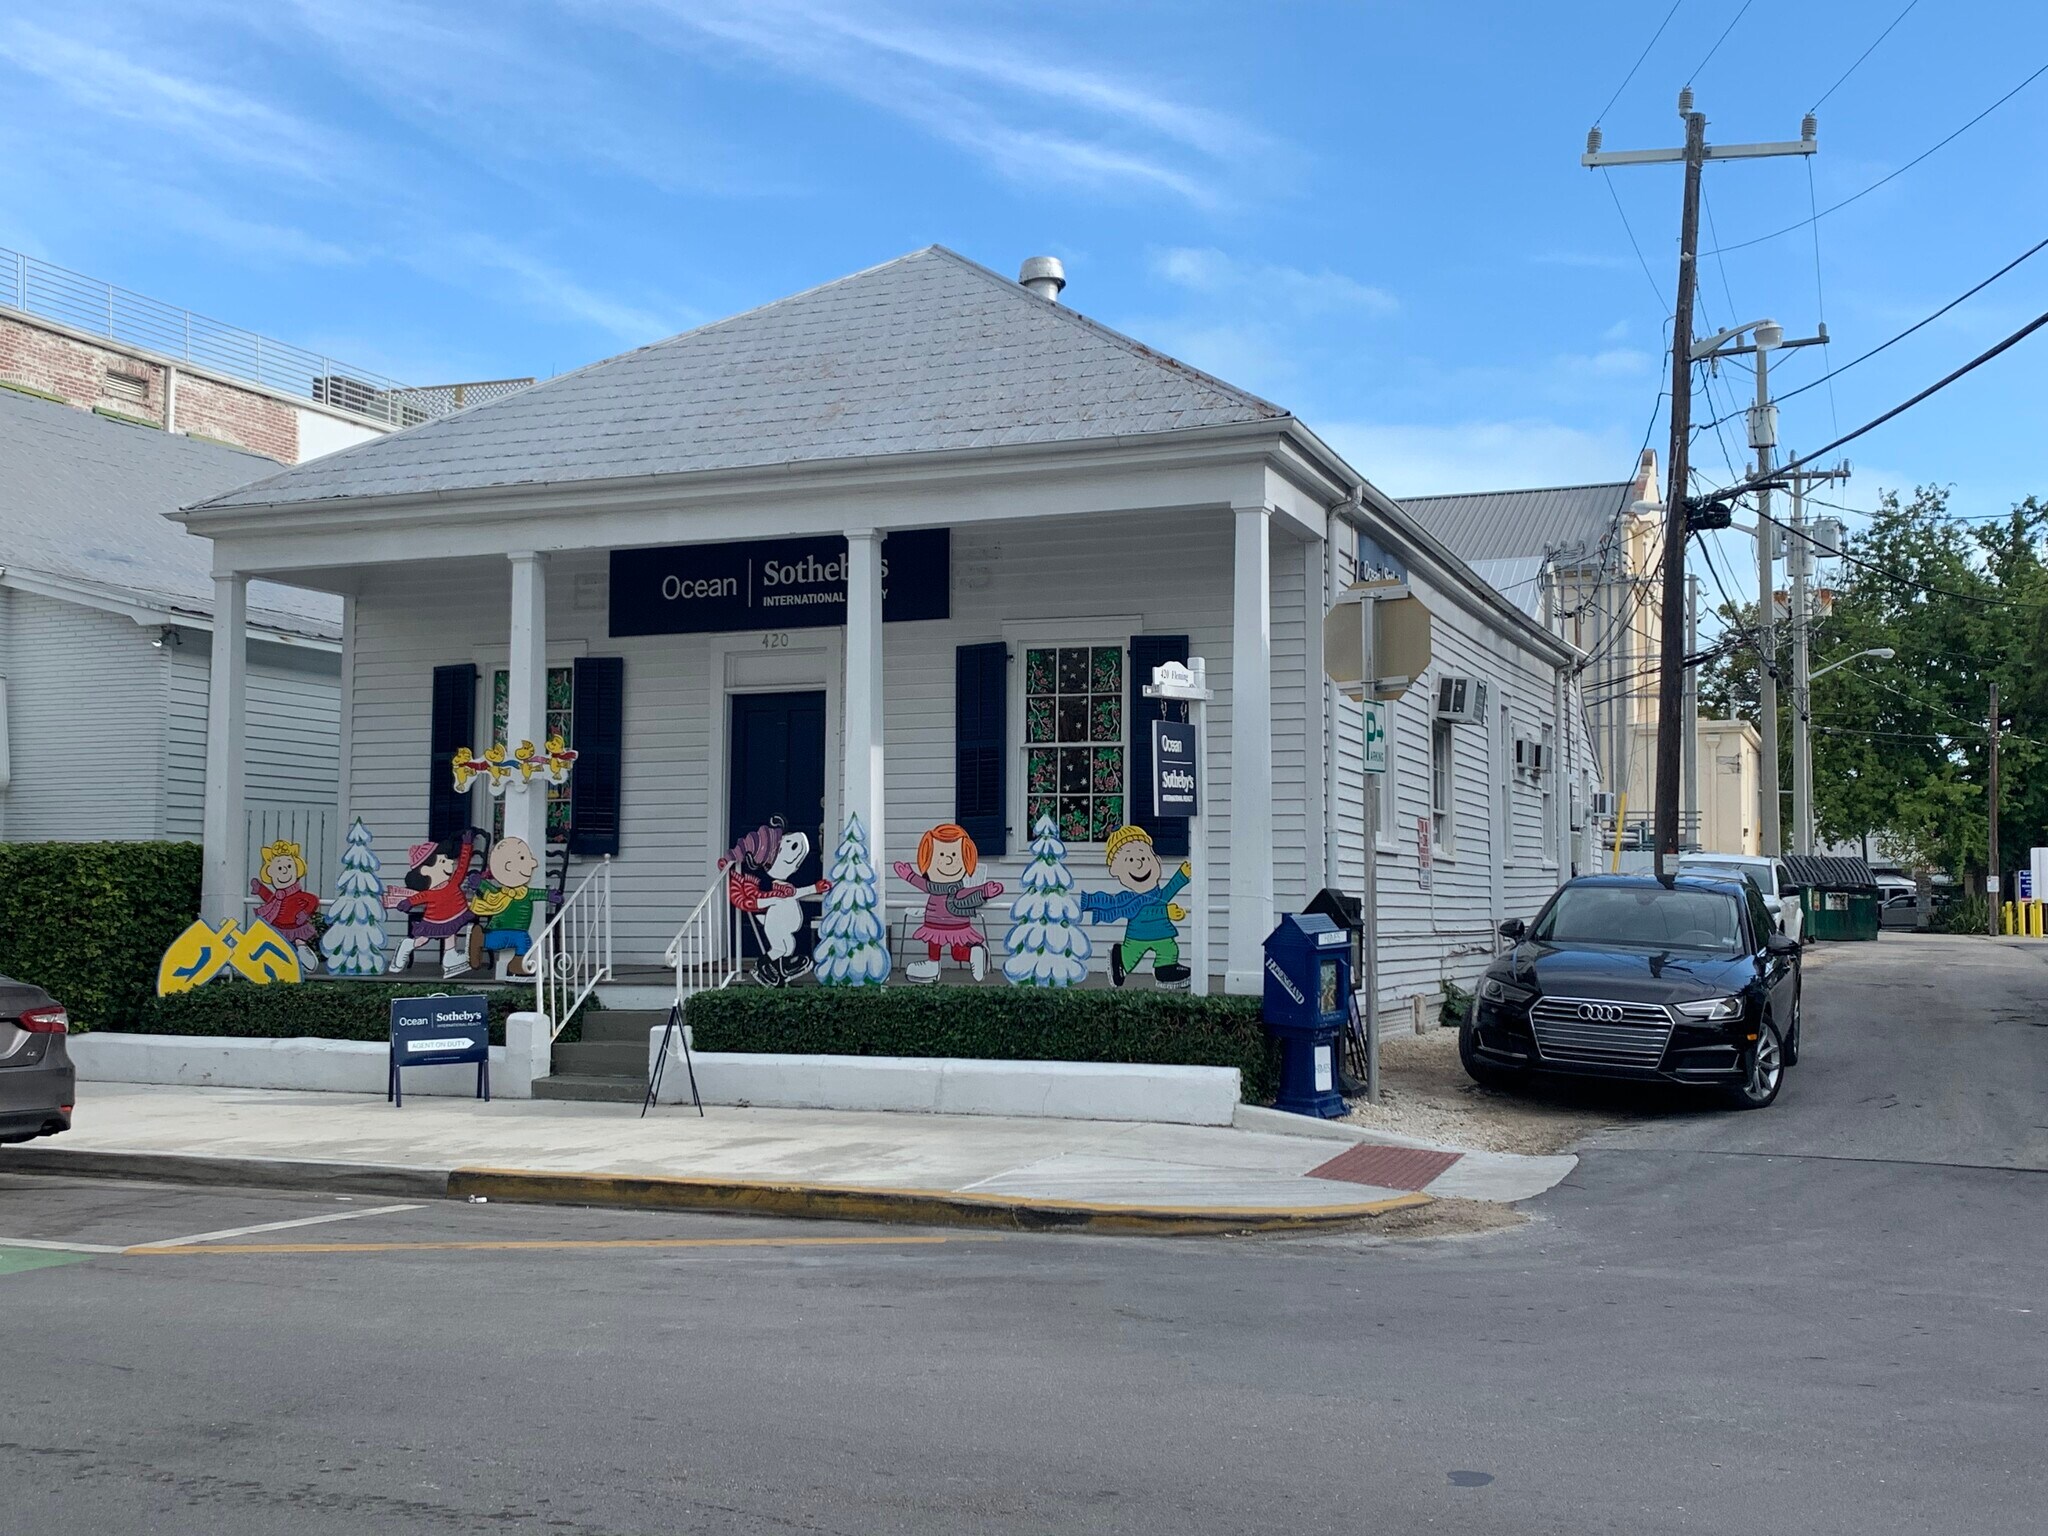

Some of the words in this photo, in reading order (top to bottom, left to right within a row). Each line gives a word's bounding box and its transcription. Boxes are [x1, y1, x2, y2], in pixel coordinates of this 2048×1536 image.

[662, 575, 737, 600] Ocean
[763, 592, 846, 607] INTERNATIONAL
[762, 633, 789, 648] 420
[1160, 668, 1170, 679] 420
[1162, 735, 1182, 752] Ocean
[1162, 769, 1194, 793] Sotheby's
[399, 1017, 429, 1027] Ocean
[436, 1011, 482, 1022] Sotheby's
[412, 1041, 434, 1049] AGENT
[435, 1041, 446, 1049] ON
[447, 1040, 466, 1048] DUTY
